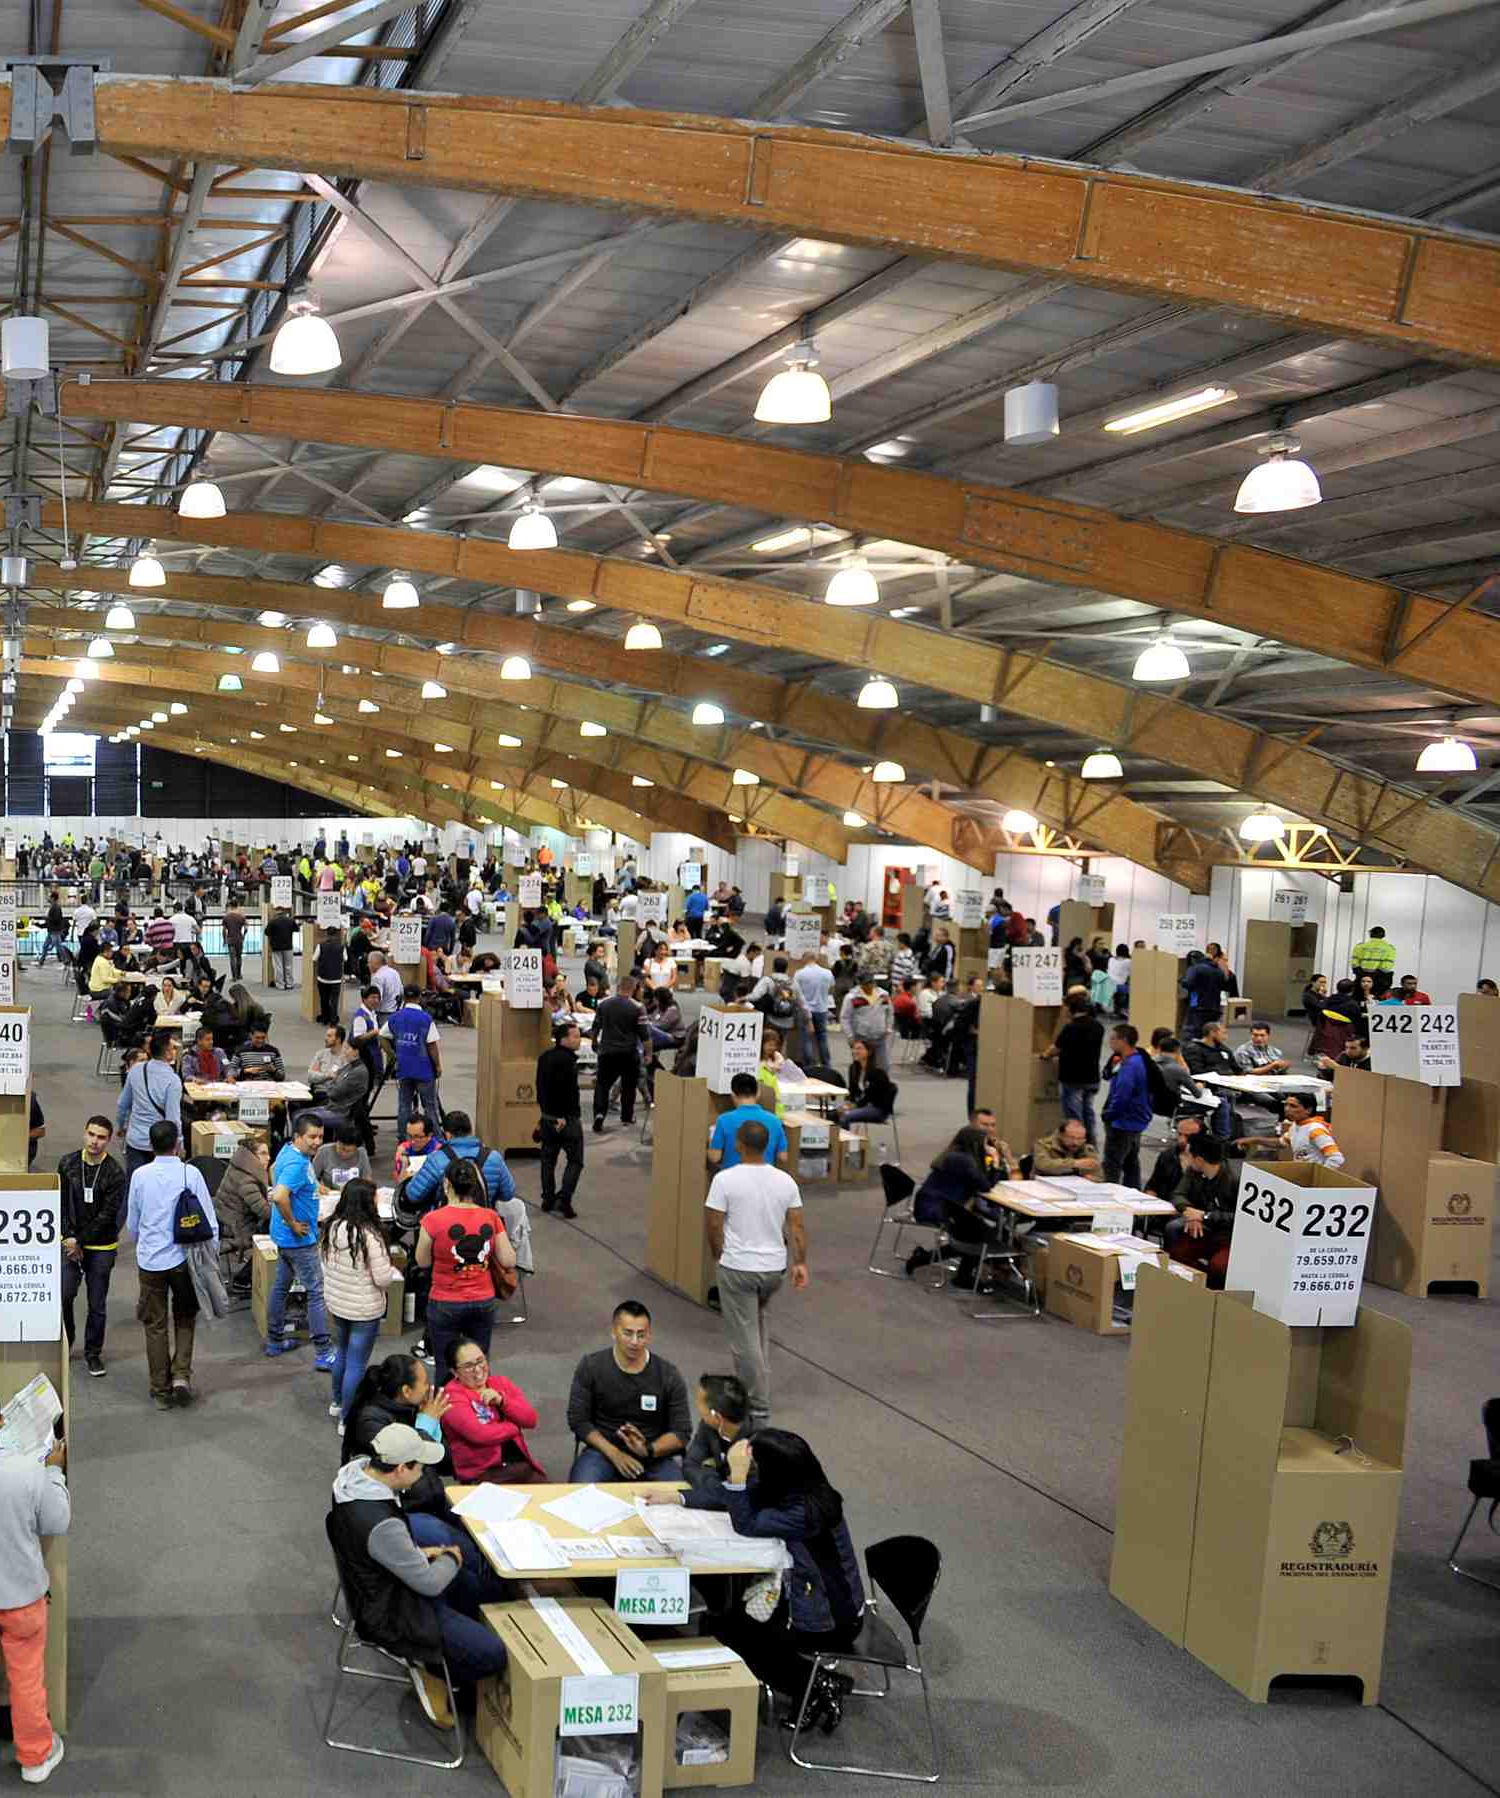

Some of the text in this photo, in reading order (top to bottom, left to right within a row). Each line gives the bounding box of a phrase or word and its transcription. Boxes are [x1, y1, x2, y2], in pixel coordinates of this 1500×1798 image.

[323, 895, 340, 905] 264
[400, 922, 419, 934] 257
[1175, 919, 1195, 930] 259
[513, 955, 539, 970] 248
[1012, 953, 1030, 968] 247
[1035, 953, 1059, 968] 247
[700, 1015, 720, 1040] 241
[1371, 1014, 1413, 1034] 242
[1420, 1014, 1456, 1034] 242
[725, 1022, 757, 1042] 241
[1241, 1181, 1294, 1234] 232
[1302, 1203, 1370, 1238] 232
[1296, 1255, 1358, 1266] 79.659.078
[1293, 1281, 1355, 1291] 79.666.016
[618, 1598, 685, 1614] MESA 232
[564, 1704, 633, 1724] MESA 232
